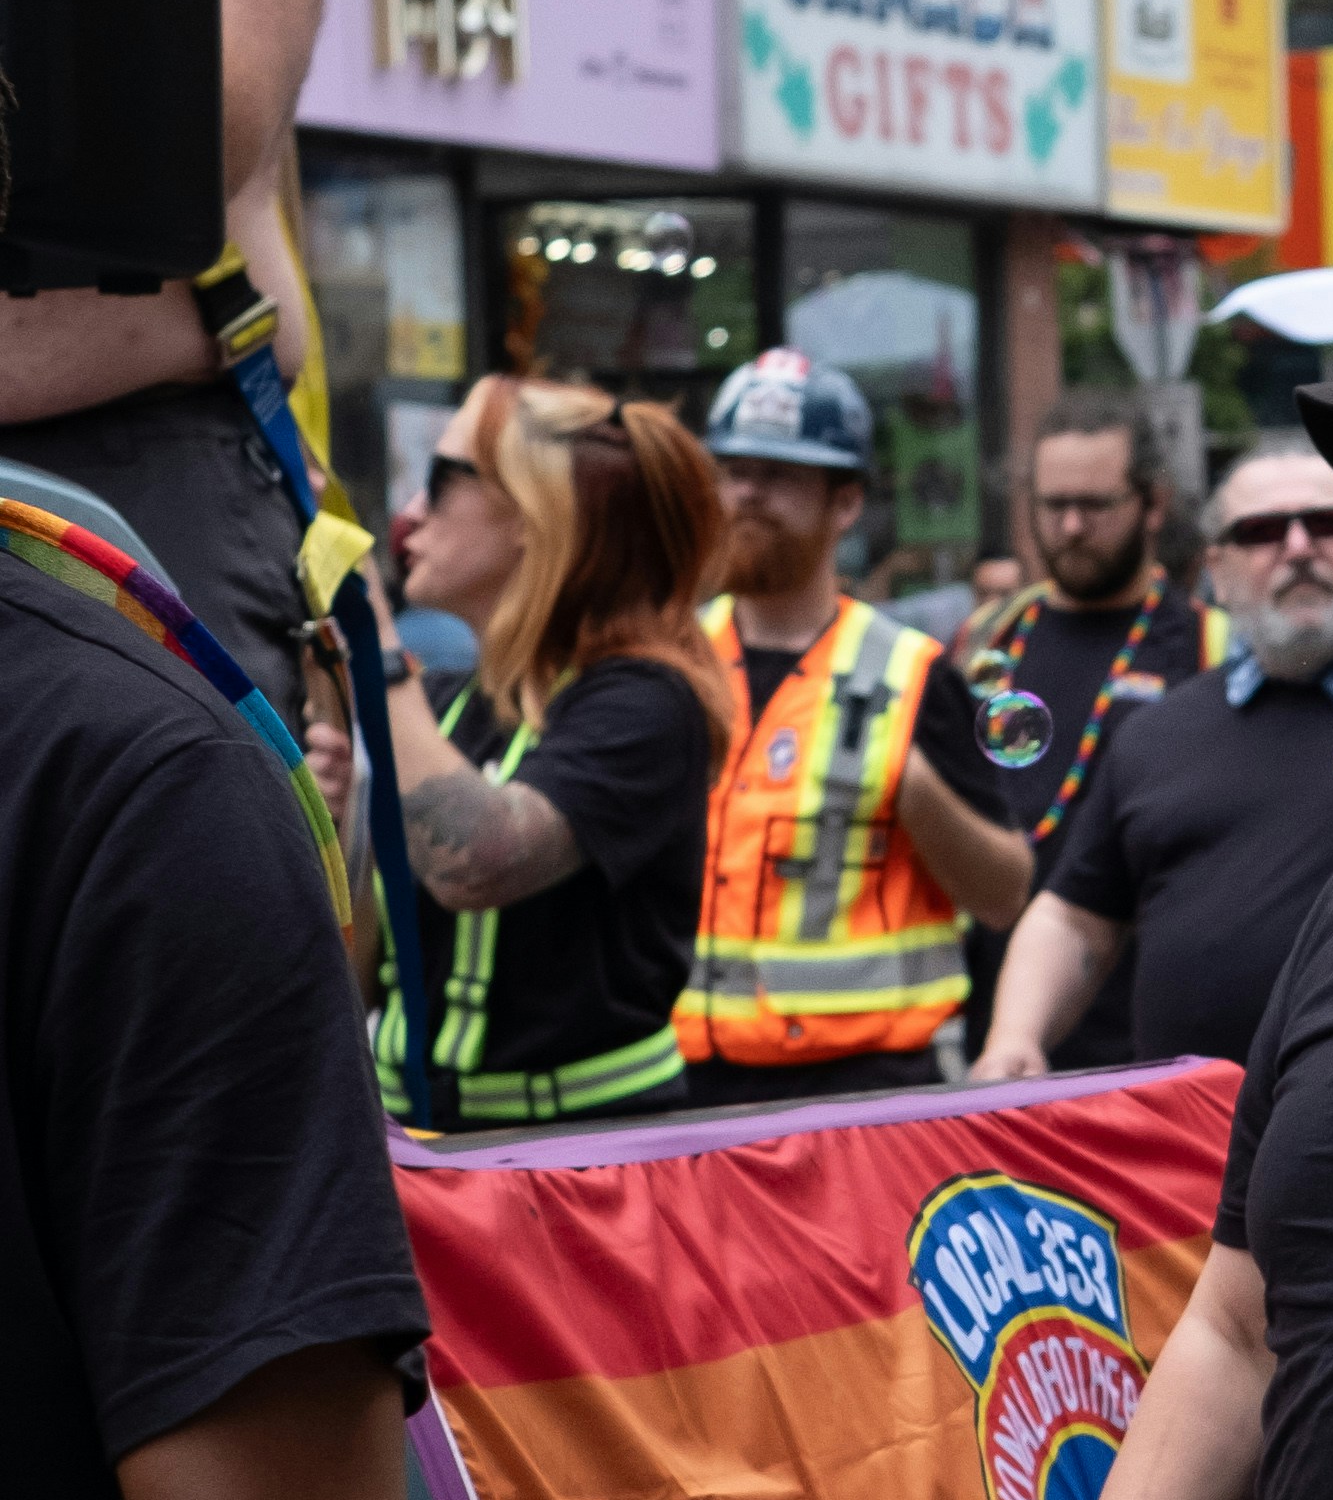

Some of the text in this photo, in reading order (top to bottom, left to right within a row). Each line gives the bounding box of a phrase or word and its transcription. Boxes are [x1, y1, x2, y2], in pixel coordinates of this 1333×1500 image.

[822, 43, 1014, 158] GIFTS
[923, 1206, 1117, 1364] LOCAL 353
[1016, 1335, 1141, 1432] BROTHER
